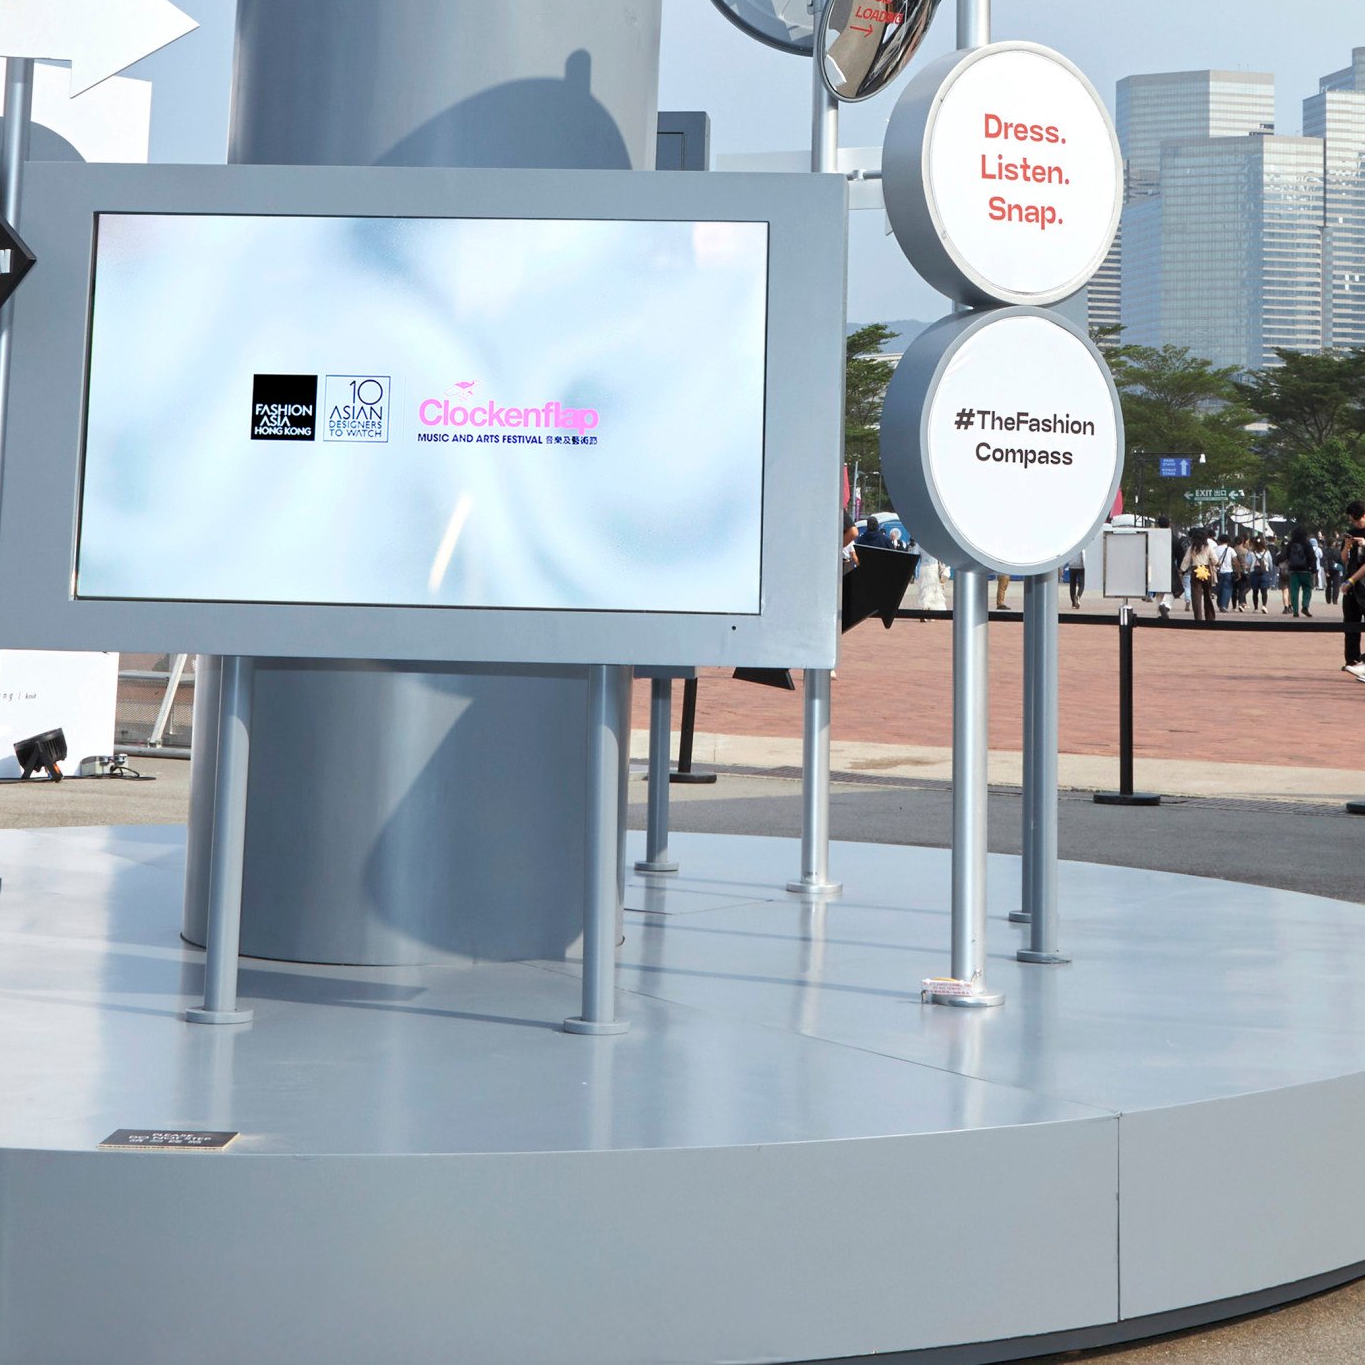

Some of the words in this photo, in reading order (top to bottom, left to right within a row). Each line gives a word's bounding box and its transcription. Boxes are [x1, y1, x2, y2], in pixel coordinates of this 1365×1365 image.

[984, 113, 1067, 145] Dress.
[980, 154, 1070, 186] Listen.
[988, 196, 1063, 231] Snap.
[350, 379, 384, 406] 10
[255, 403, 313, 417] FASHION
[330, 406, 383, 421] ASIAN
[418, 398, 599, 434] Clockenflap
[254, 425, 283, 436] HONG
[284, 426, 311, 436] KONG
[259, 415, 290, 427] ASIA
[329, 421, 383, 429] DESIGNERS
[954, 407, 1095, 436] #TheFashion
[330, 429, 344, 437] TO
[346, 429, 383, 438] WATCH
[417, 432, 450, 443] MUSIC
[452, 433, 474, 444] AND
[476, 434, 500, 444] ARTS
[502, 434, 542, 445] FESTIVAL
[975, 441, 1073, 469] Compass
